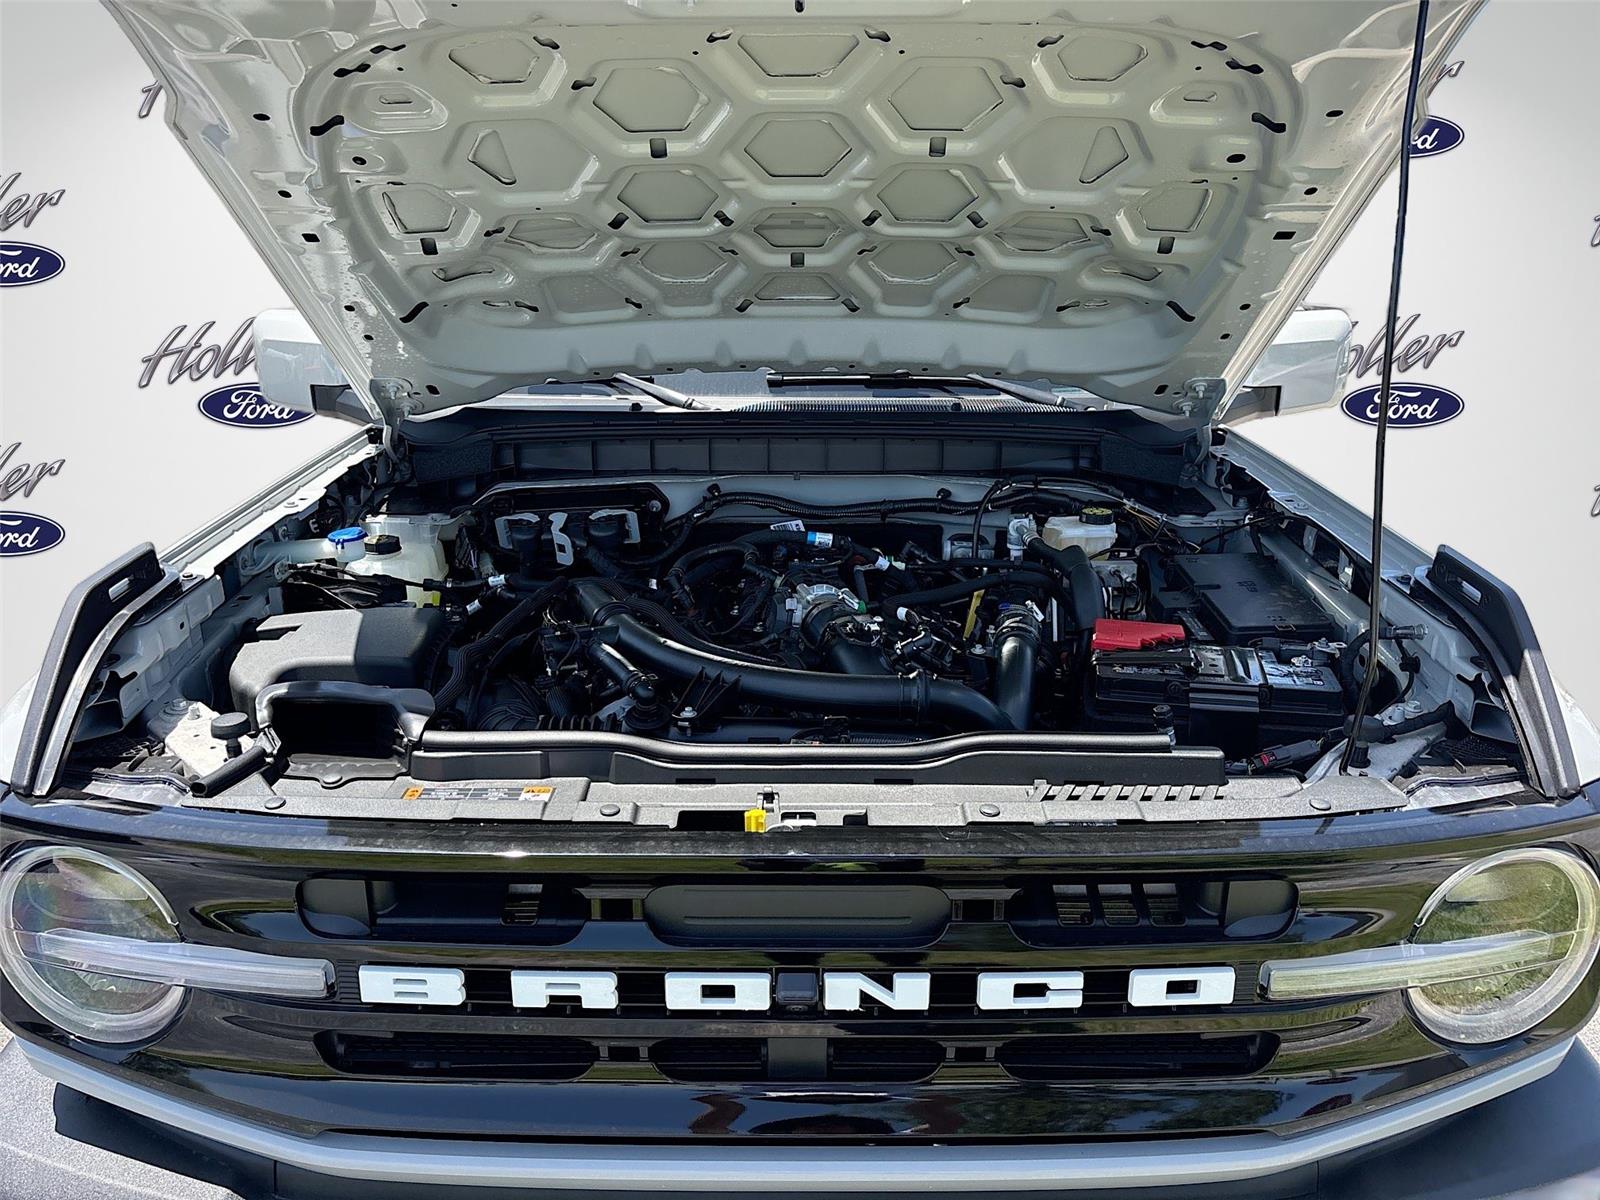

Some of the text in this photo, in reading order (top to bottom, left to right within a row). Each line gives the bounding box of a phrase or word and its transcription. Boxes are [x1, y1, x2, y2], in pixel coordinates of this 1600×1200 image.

[0, 250, 40, 278] rd
[1366, 389, 1440, 419] Ford
[0, 520, 40, 548] rd
[358, 965, 1236, 1011] BRONCO
